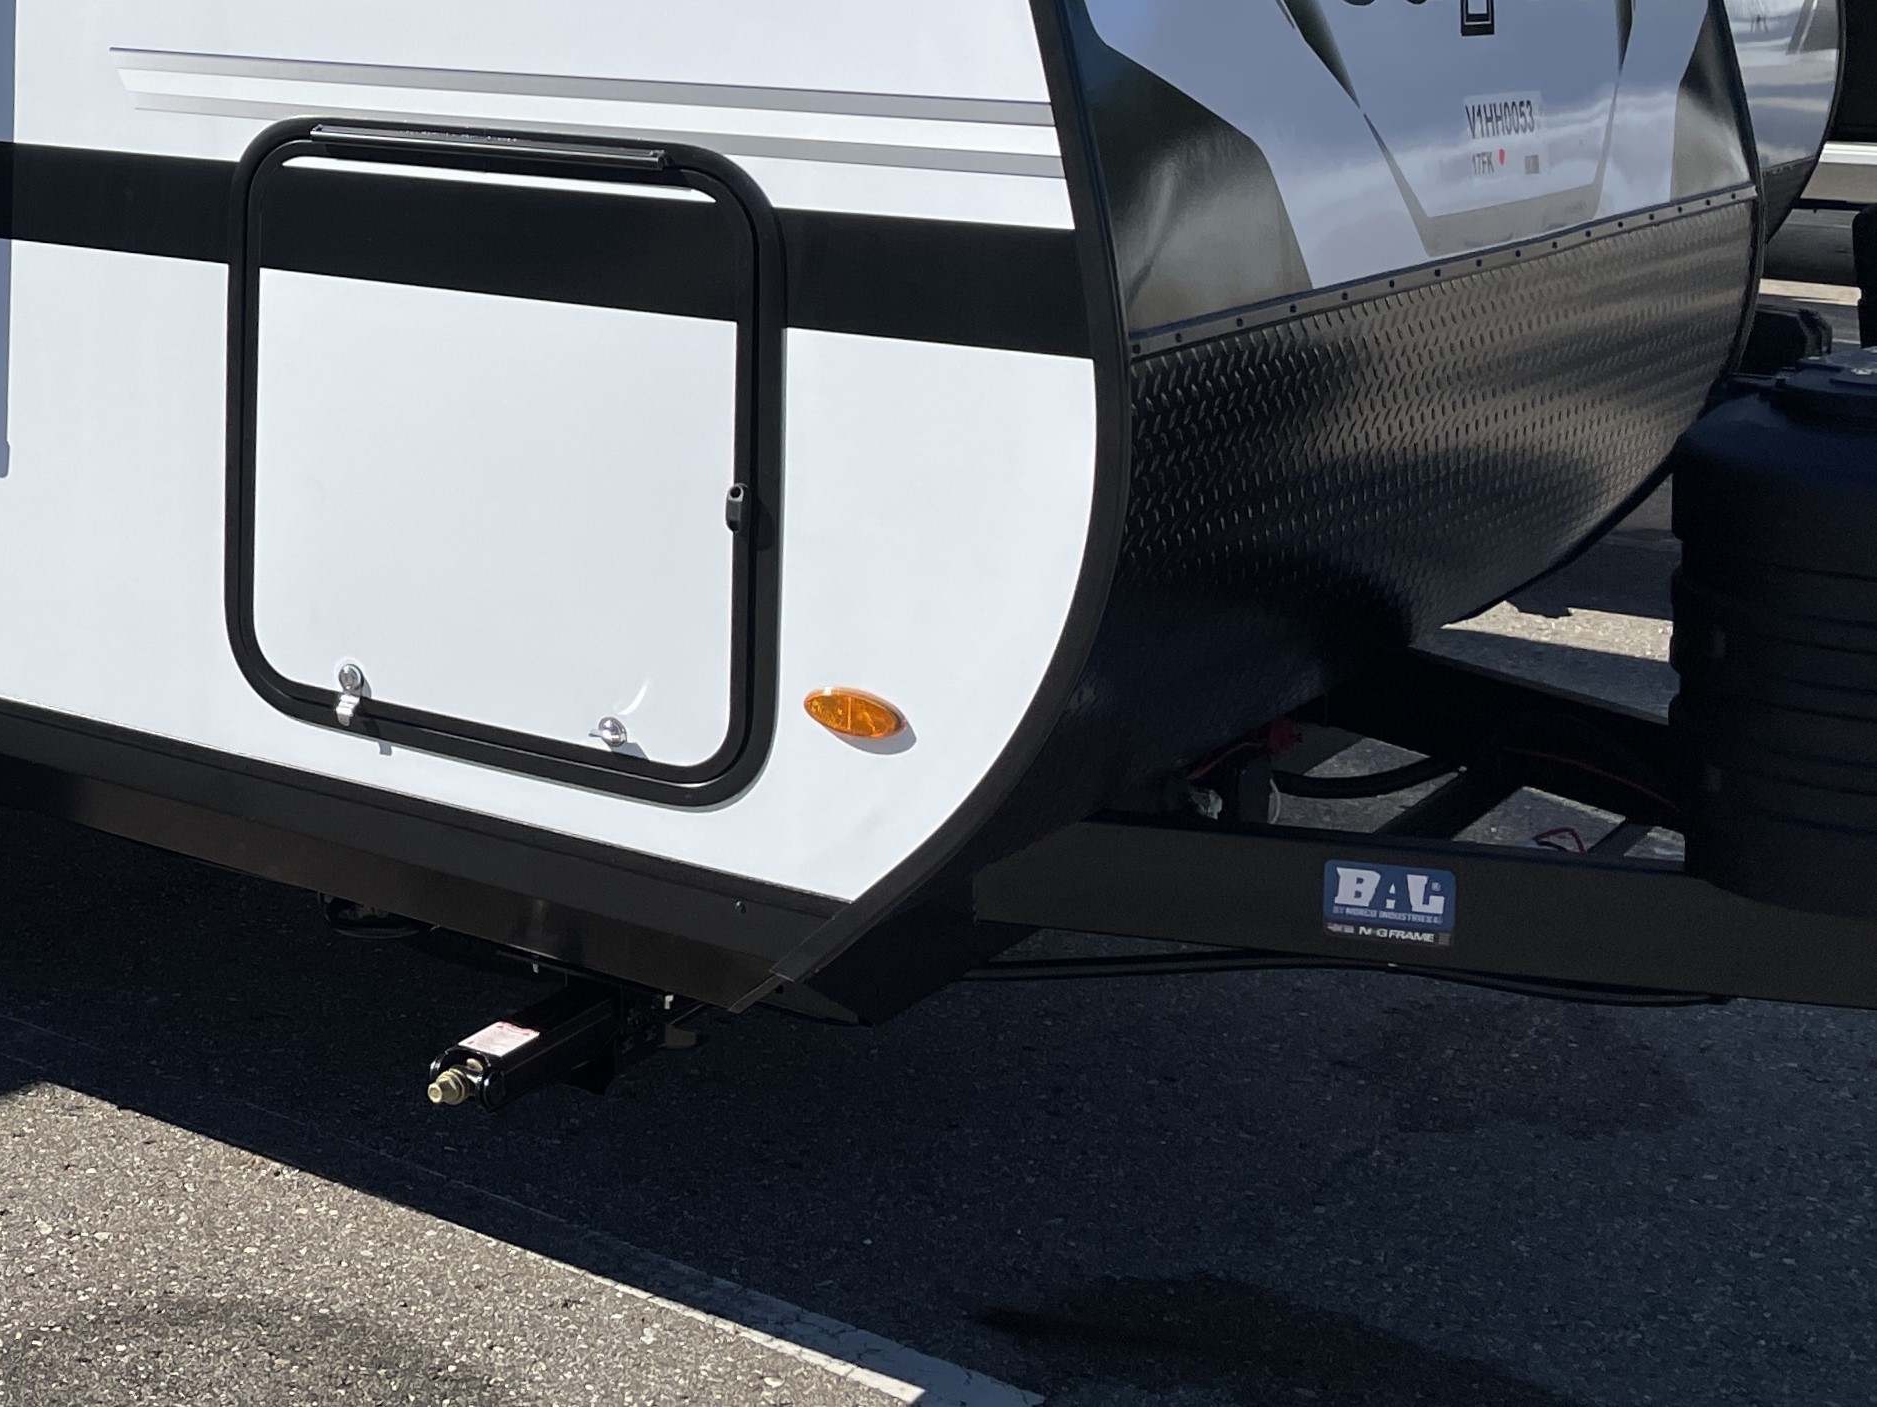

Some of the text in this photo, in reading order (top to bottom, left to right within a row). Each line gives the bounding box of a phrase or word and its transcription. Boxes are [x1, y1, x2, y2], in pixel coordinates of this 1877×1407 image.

[1465, 99, 1535, 140] V1HH0053
[1471, 152, 1495, 175] 17FK
[1334, 867, 1445, 915] BAL
